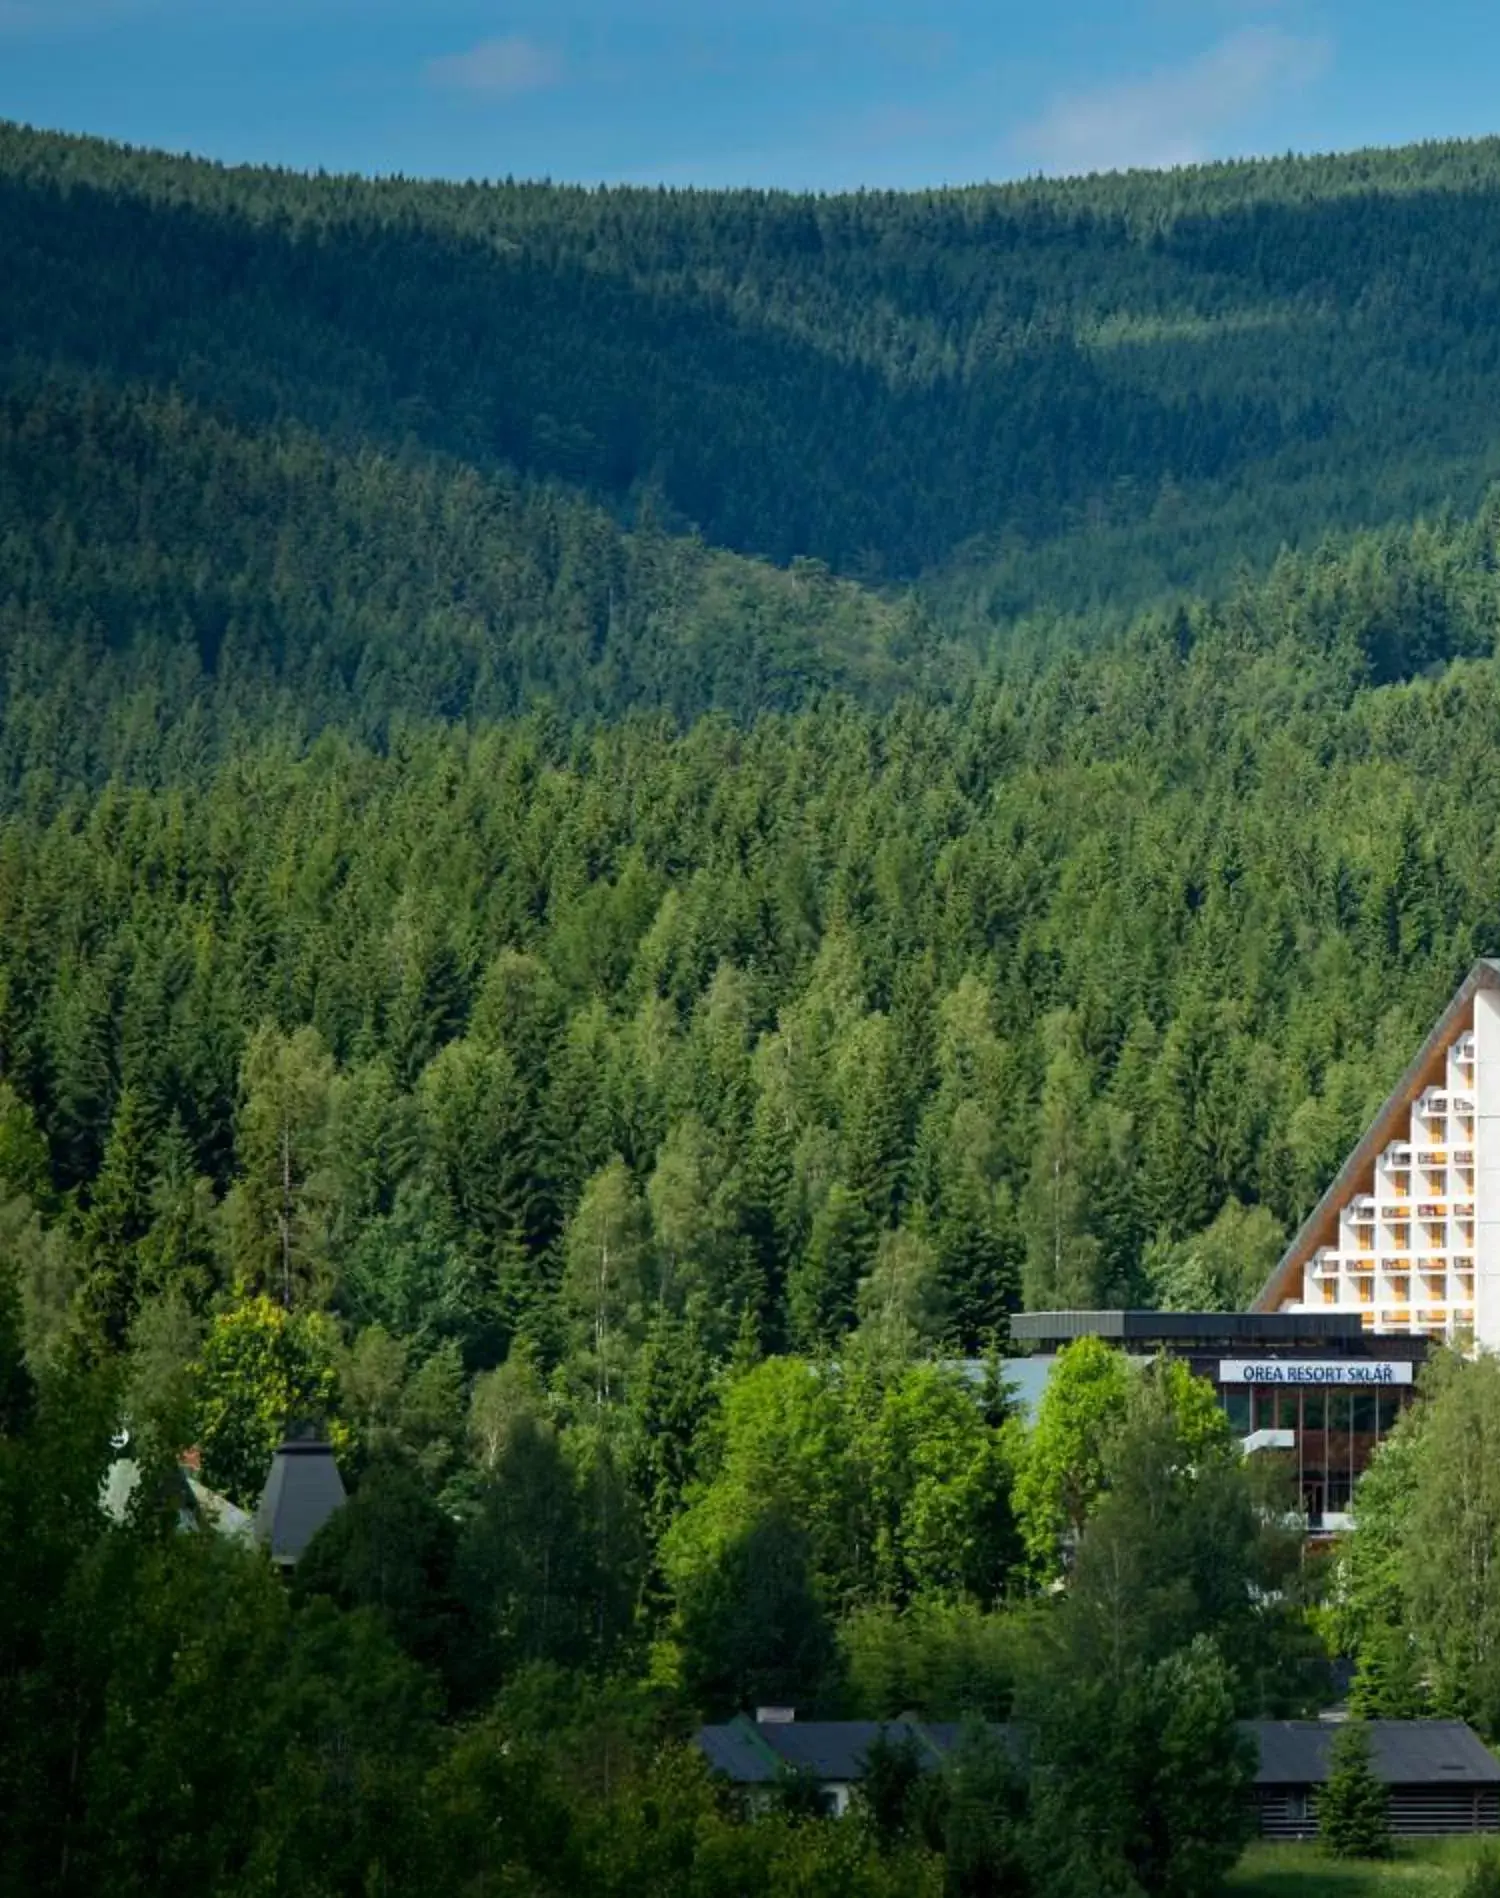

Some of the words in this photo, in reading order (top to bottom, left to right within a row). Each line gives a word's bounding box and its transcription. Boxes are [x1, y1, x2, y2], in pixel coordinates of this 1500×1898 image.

[1243, 1366, 1283, 1381] OREA
[1287, 1367, 1342, 1381] RESORT
[1348, 1364, 1393, 1381] SKLÁŘ
